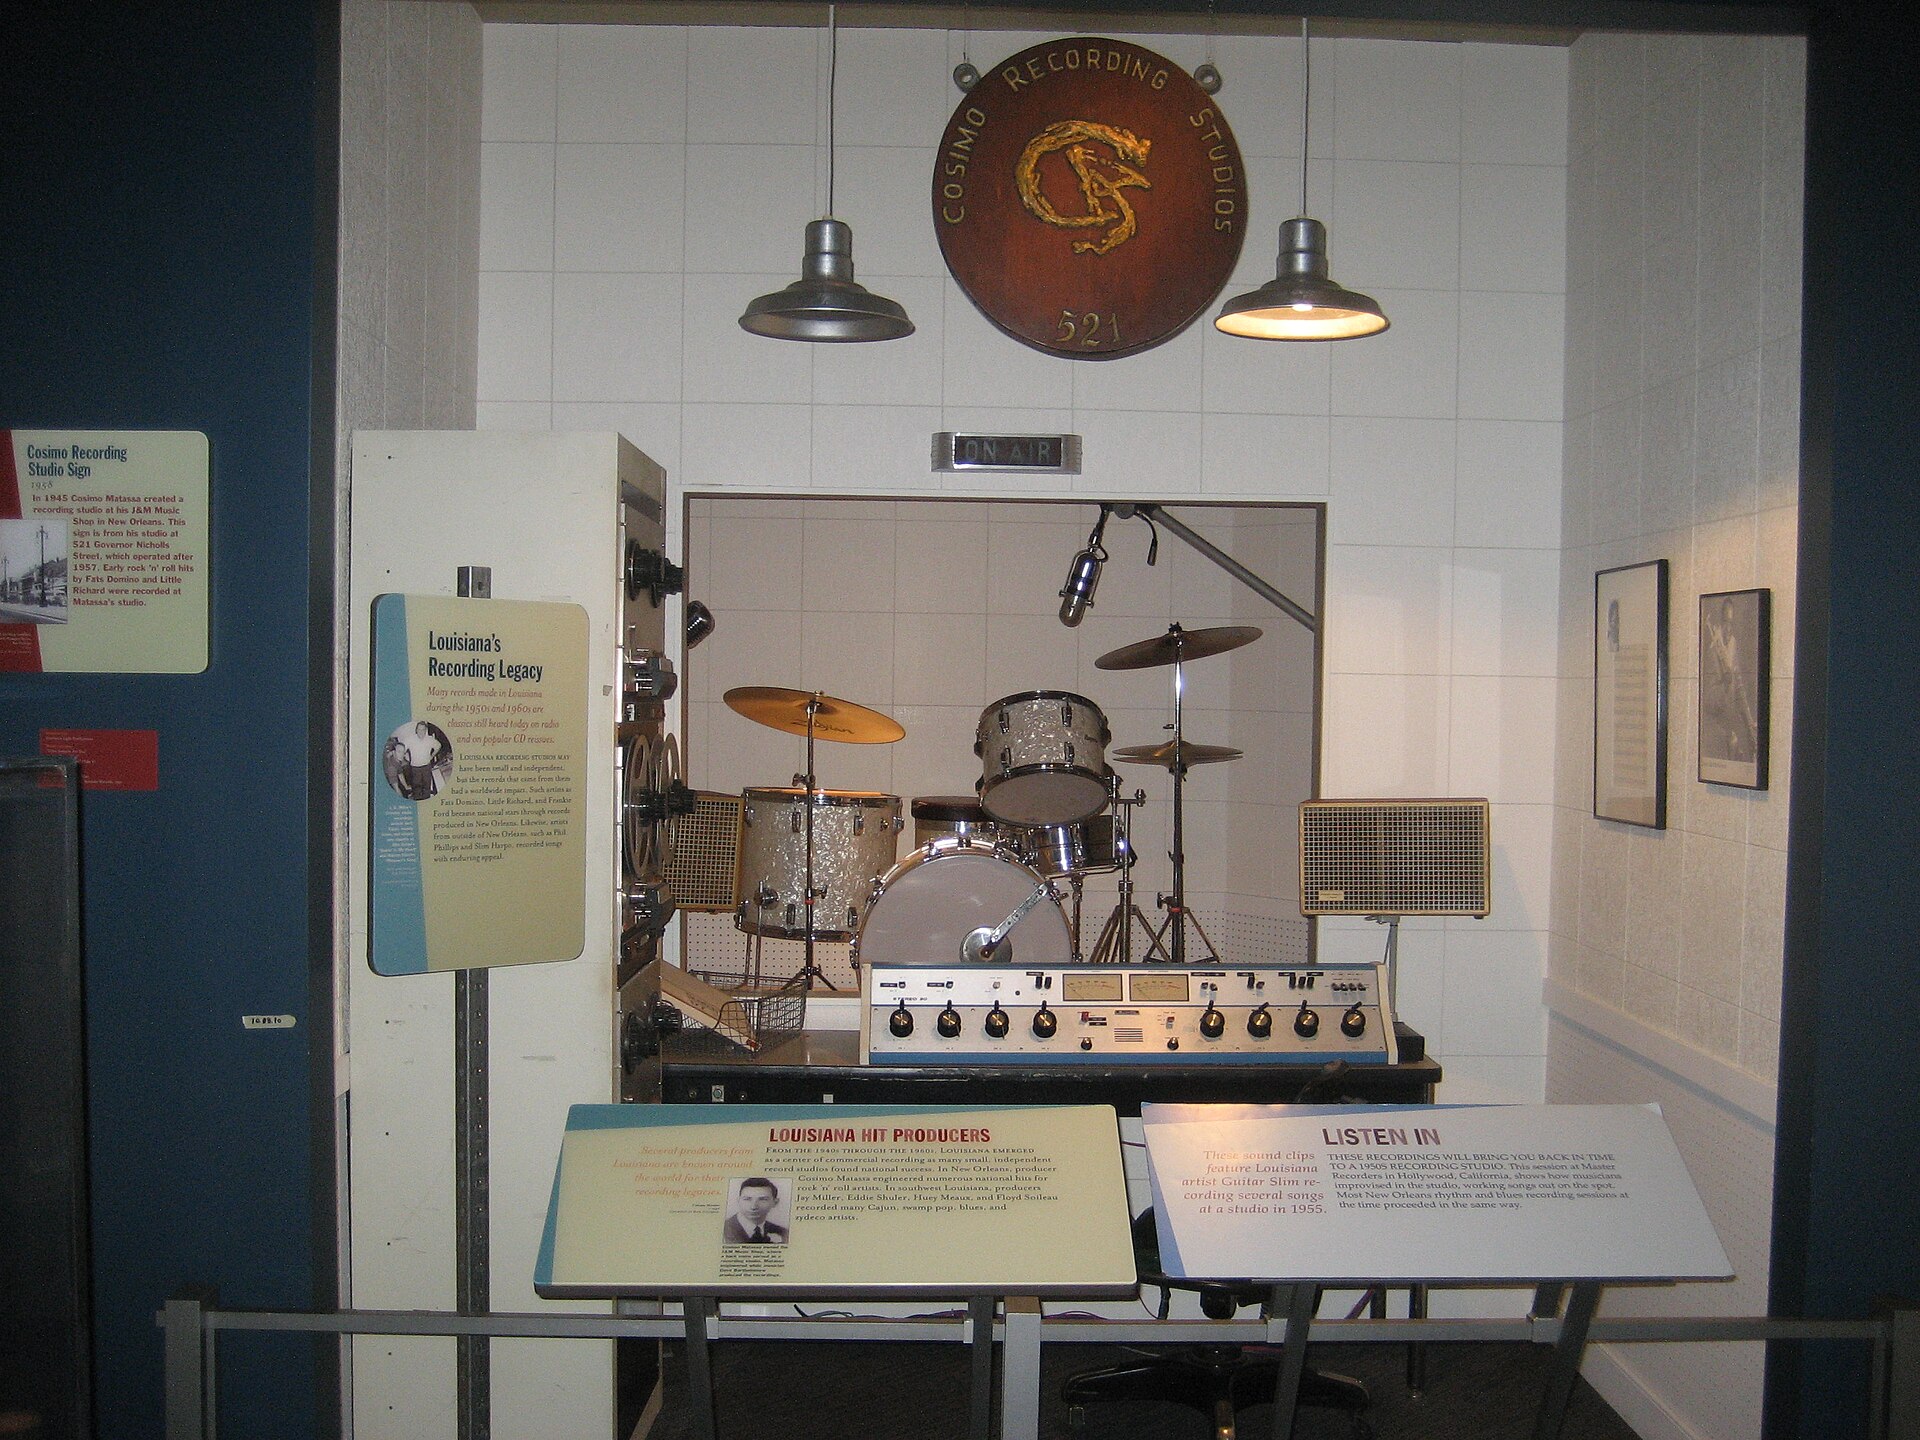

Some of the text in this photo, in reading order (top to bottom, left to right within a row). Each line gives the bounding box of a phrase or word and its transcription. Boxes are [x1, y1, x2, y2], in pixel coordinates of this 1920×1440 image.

[943, 48, 1236, 234] COSIMO RECORDING STUDIOS
[1056, 310, 1121, 347] 521
[27, 445, 128, 462] Cosimo Recording
[965, 439, 1050, 465] ON AIR
[28, 462, 91, 479] Studio Sign
[429, 630, 501, 652] Louisiana's
[429, 657, 543, 682] Recording Legacy
[769, 1128, 990, 1142] LOUISIANA HIT PRODUCERS
[1322, 1128, 1441, 1145] LISTEN IN
[1204, 1151, 1315, 1161] These sound clips
[1327, 1153, 1615, 1161] THESE RECORDINGS WILL BRING YOU BACK IN TIME
[1206, 1163, 1318, 1173] feature Louisiana
[1181, 1177, 1216, 1186] artist
[1222, 1177, 1264, 1186] Guitar
[1270, 1177, 1299, 1186] Slim
[1184, 1190, 1324, 1201] cording several songs
[1199, 1204, 1211, 1214] at
[1228, 1204, 1271, 1214] studio
[1273, 1204, 1288, 1214] in
